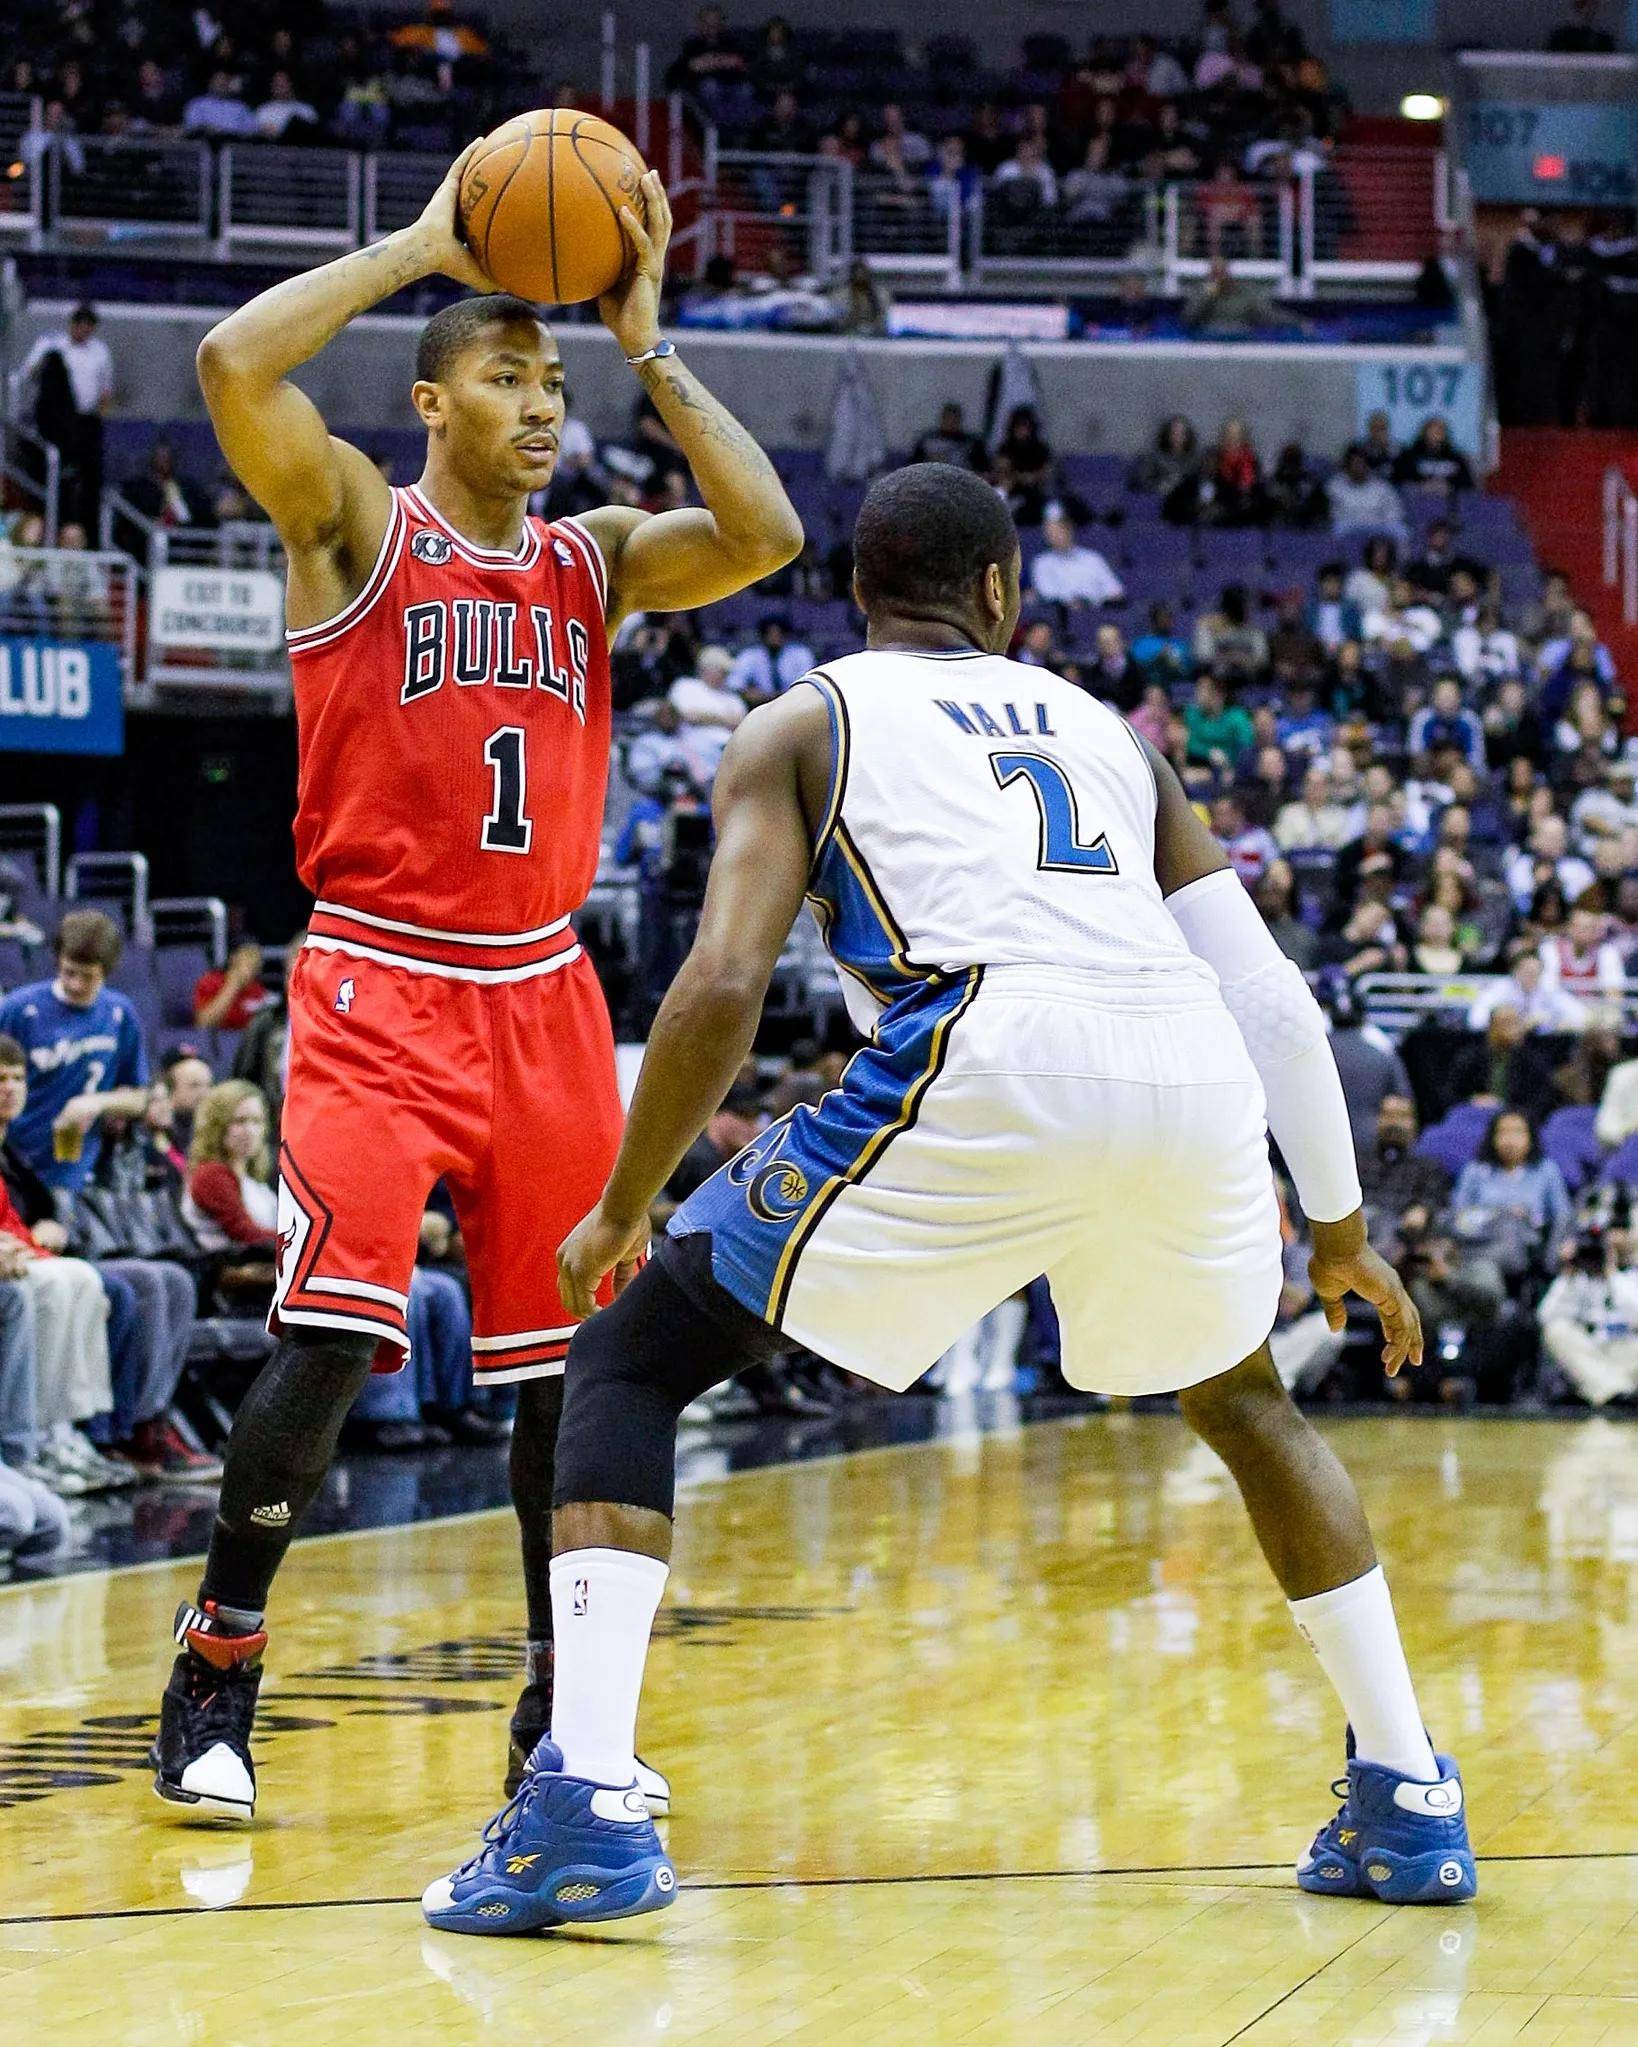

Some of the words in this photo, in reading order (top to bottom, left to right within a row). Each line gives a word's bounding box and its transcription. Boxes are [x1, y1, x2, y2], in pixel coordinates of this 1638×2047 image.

[1383, 363, 1462, 407] 107
[400, 599, 589, 727] BULLS
[932, 699, 1057, 738] WALL
[480, 726, 533, 855] 1
[988, 751, 1120, 876] 2
